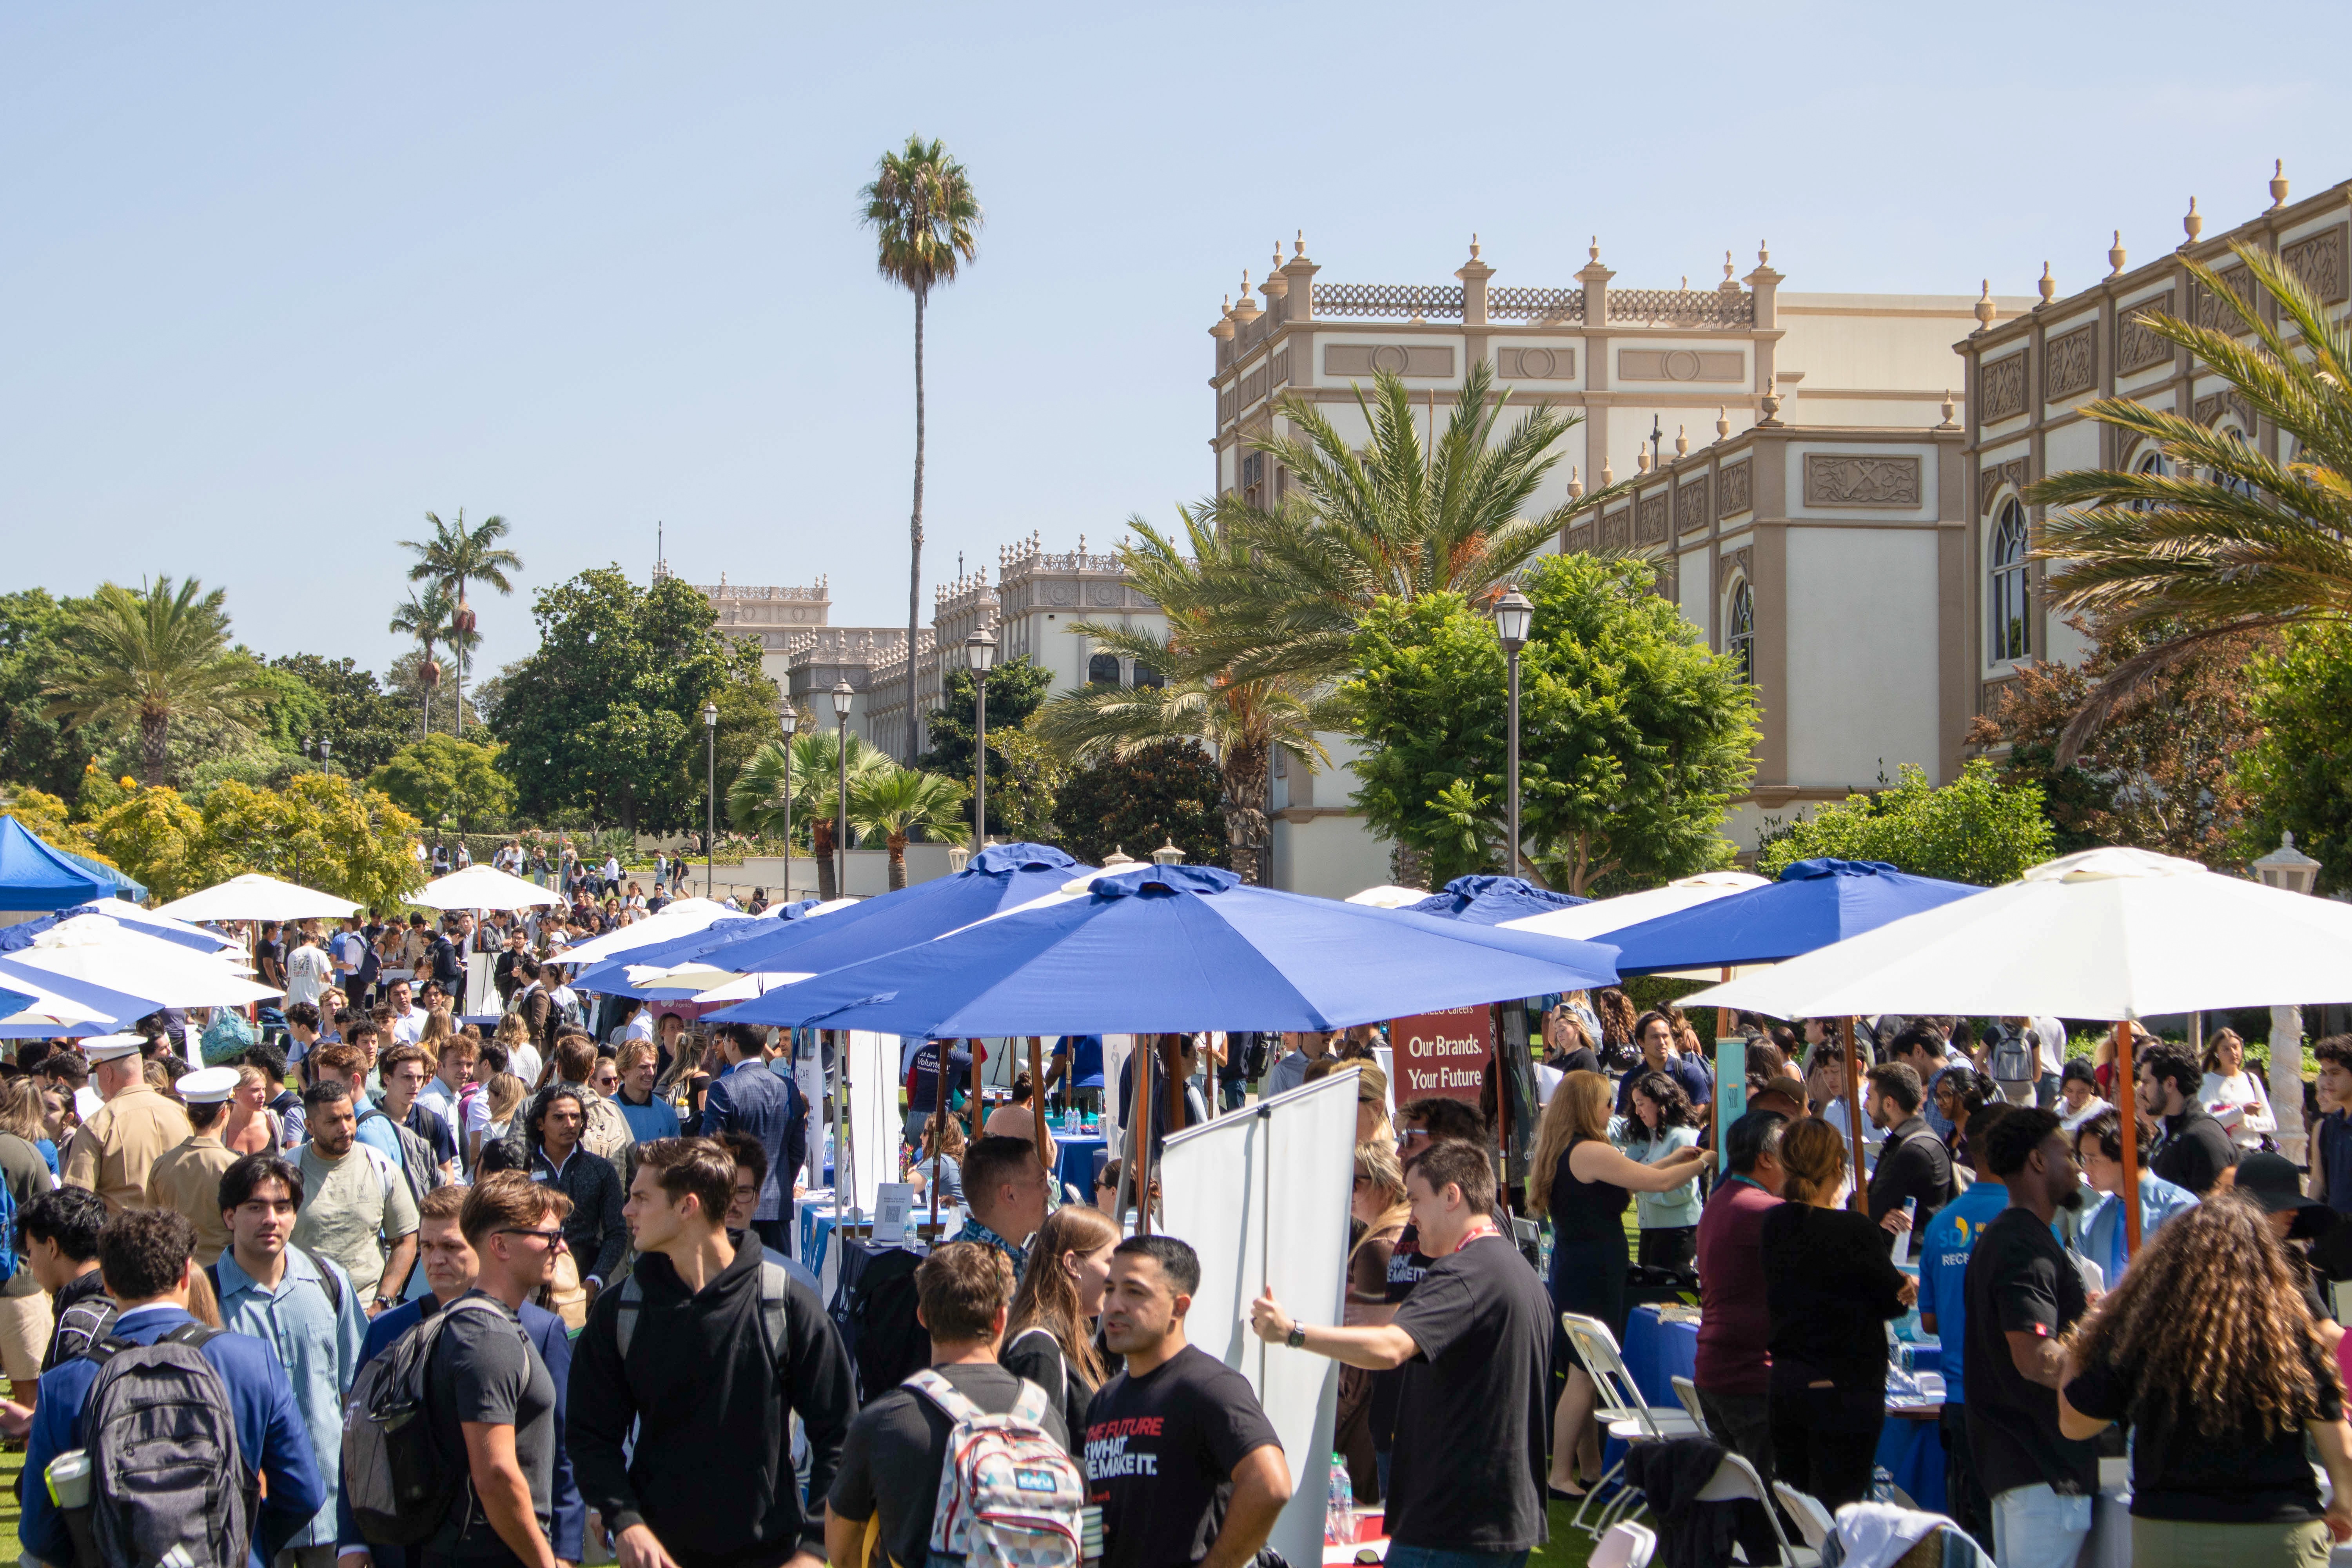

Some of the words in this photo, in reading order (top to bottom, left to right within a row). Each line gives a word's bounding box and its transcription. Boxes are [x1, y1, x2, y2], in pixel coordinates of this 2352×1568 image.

[1409, 1036, 1434, 1058] Our
[1436, 1033, 1482, 1056] Brands.
[1407, 1069, 1438, 1089] Your
[1440, 1067, 1482, 1088] Future
[1104, 1416, 1164, 1439] FUTURE
[1090, 1435, 1128, 1460] WHAT
[1098, 1452, 1136, 1479] MAKE
[1136, 1452, 1158, 1476] IT.
